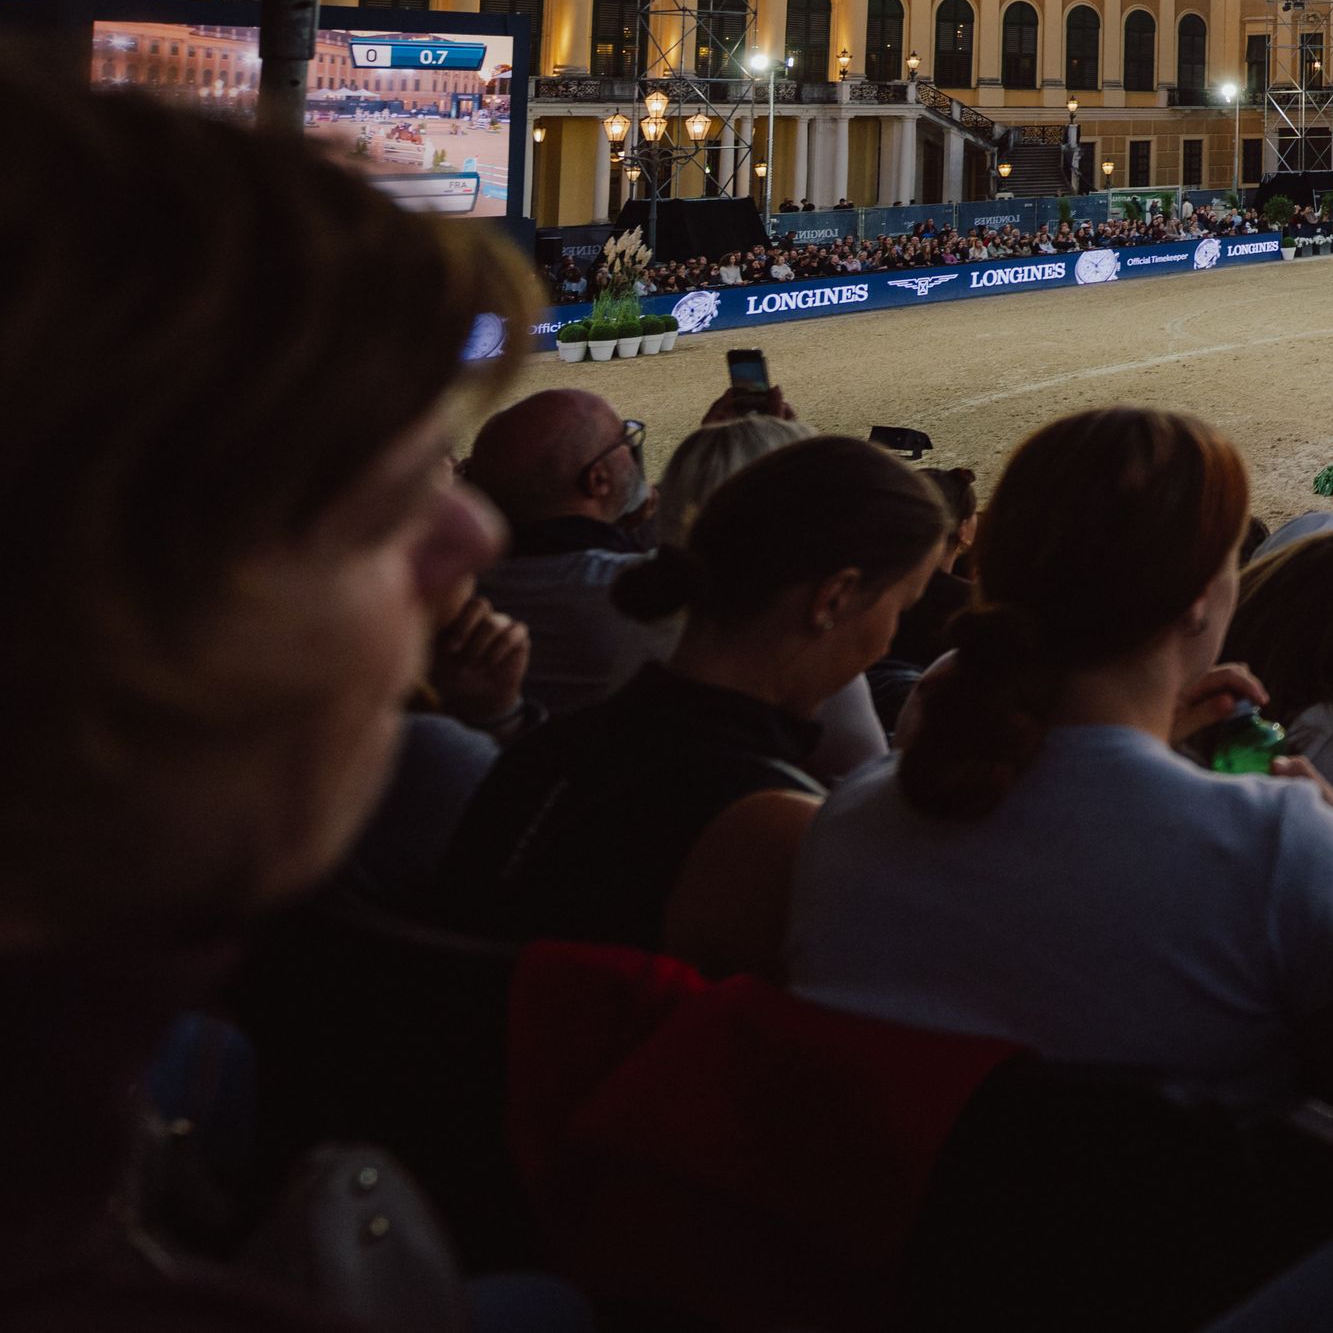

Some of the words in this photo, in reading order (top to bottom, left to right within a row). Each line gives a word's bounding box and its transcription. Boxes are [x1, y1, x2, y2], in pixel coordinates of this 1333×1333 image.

[366, 48, 377, 62] 0
[420, 50, 449, 65] 0.7
[1227, 241, 1279, 257] LONGINES
[1127, 256, 1150, 266] Official
[1150, 253, 1188, 264] Timekeeper
[970, 262, 1066, 288] LONGINES
[746, 284, 869, 314] LONGINES
